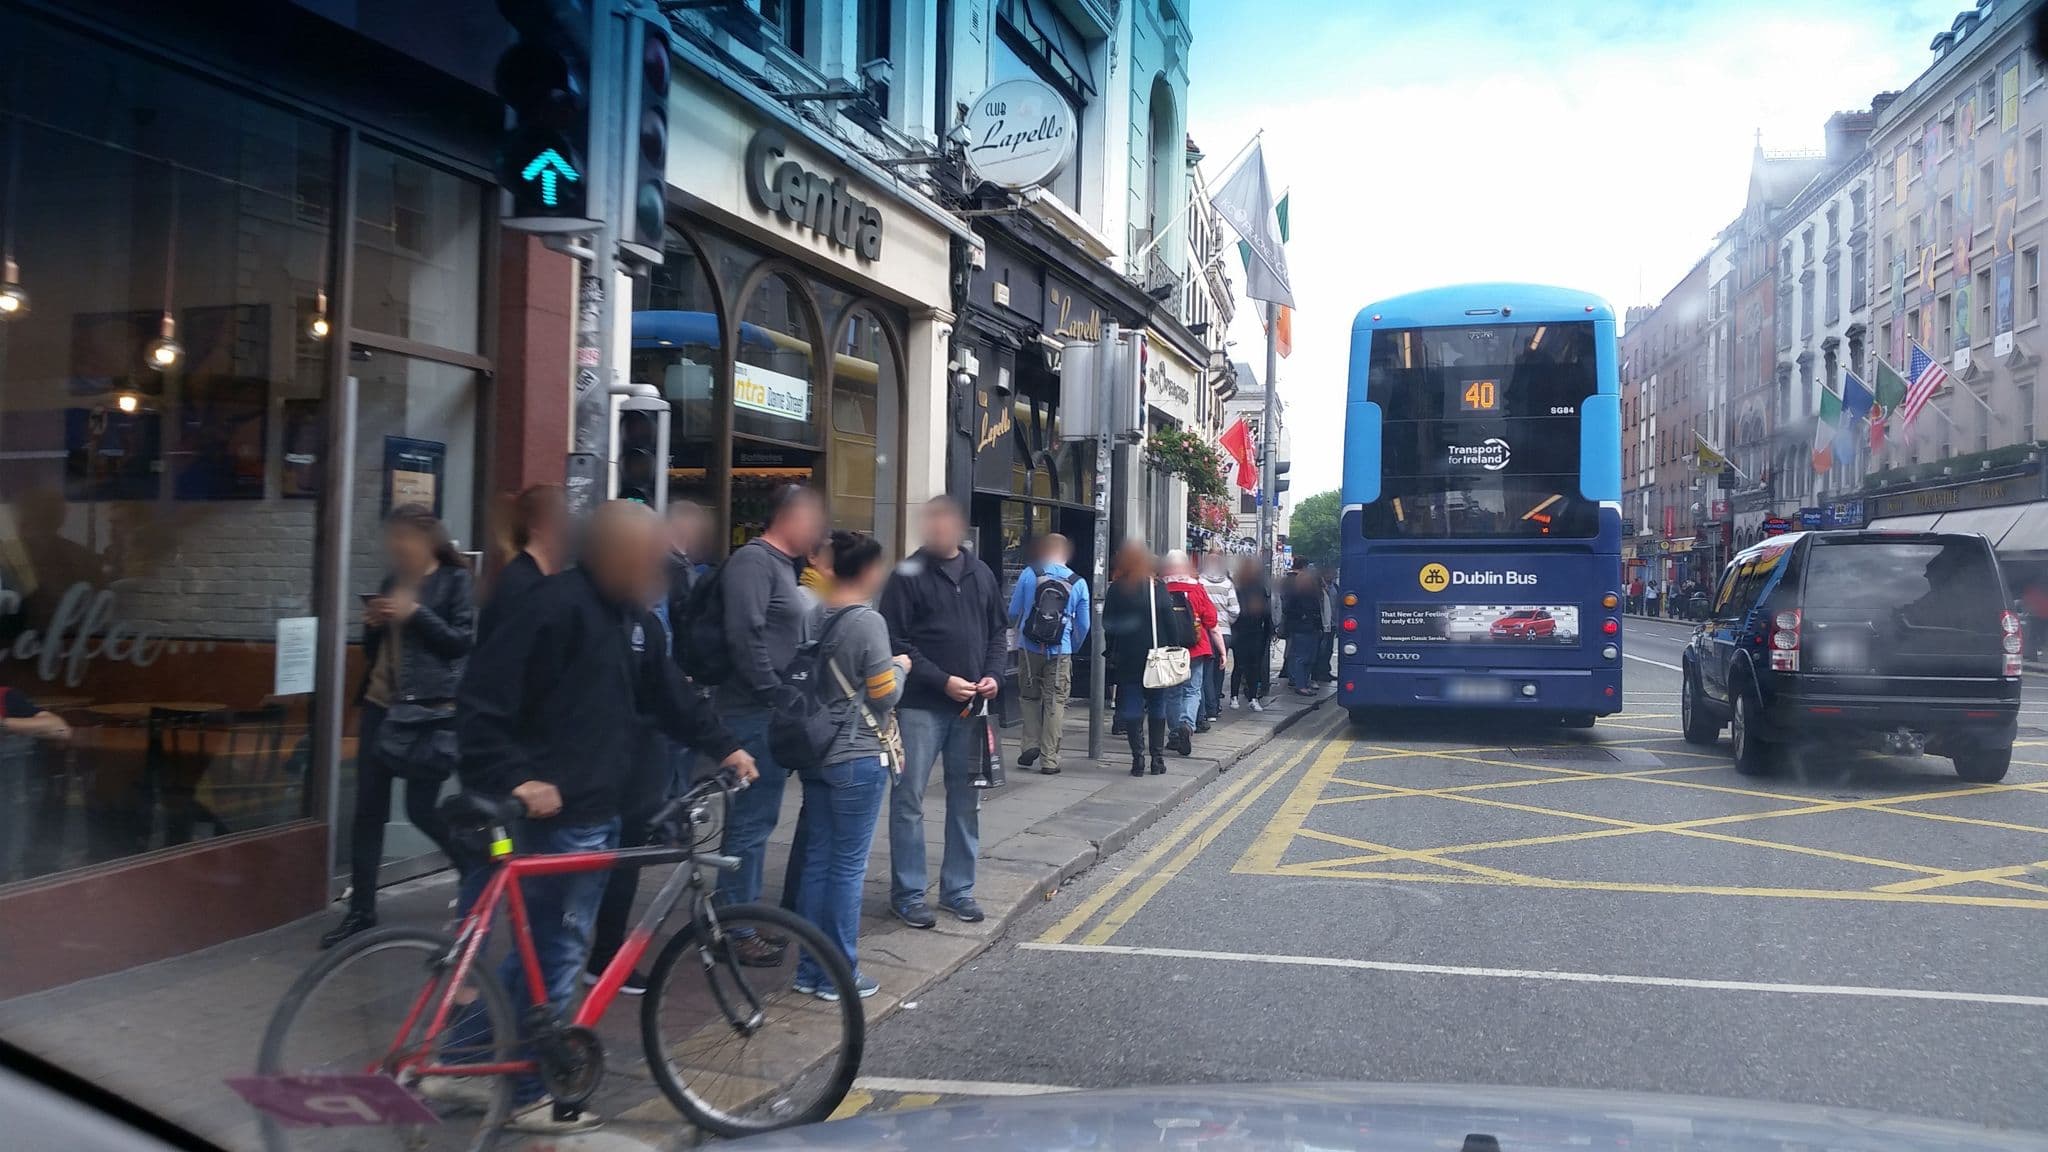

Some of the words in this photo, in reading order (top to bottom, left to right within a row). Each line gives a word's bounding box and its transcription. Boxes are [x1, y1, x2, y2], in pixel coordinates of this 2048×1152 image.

[985, 102, 1007, 117] CLUB
[971, 114, 1063, 153] Lapello
[746, 127, 884, 263] Centra
[1054, 295, 1101, 344] Lapell
[735, 379, 765, 405] ntra
[1465, 382, 1495, 409] 40
[1550, 406, 1574, 415] SG84
[1448, 445, 1502, 456] Transport
[1448, 456, 1463, 465] for
[1463, 456, 1502, 464] Ireland
[1452, 570, 1504, 585] Dublin
[1506, 571, 1538, 585] Bus
[1425, 611, 1449, 619] Feeling
[1377, 652, 1421, 661] VOLVO
